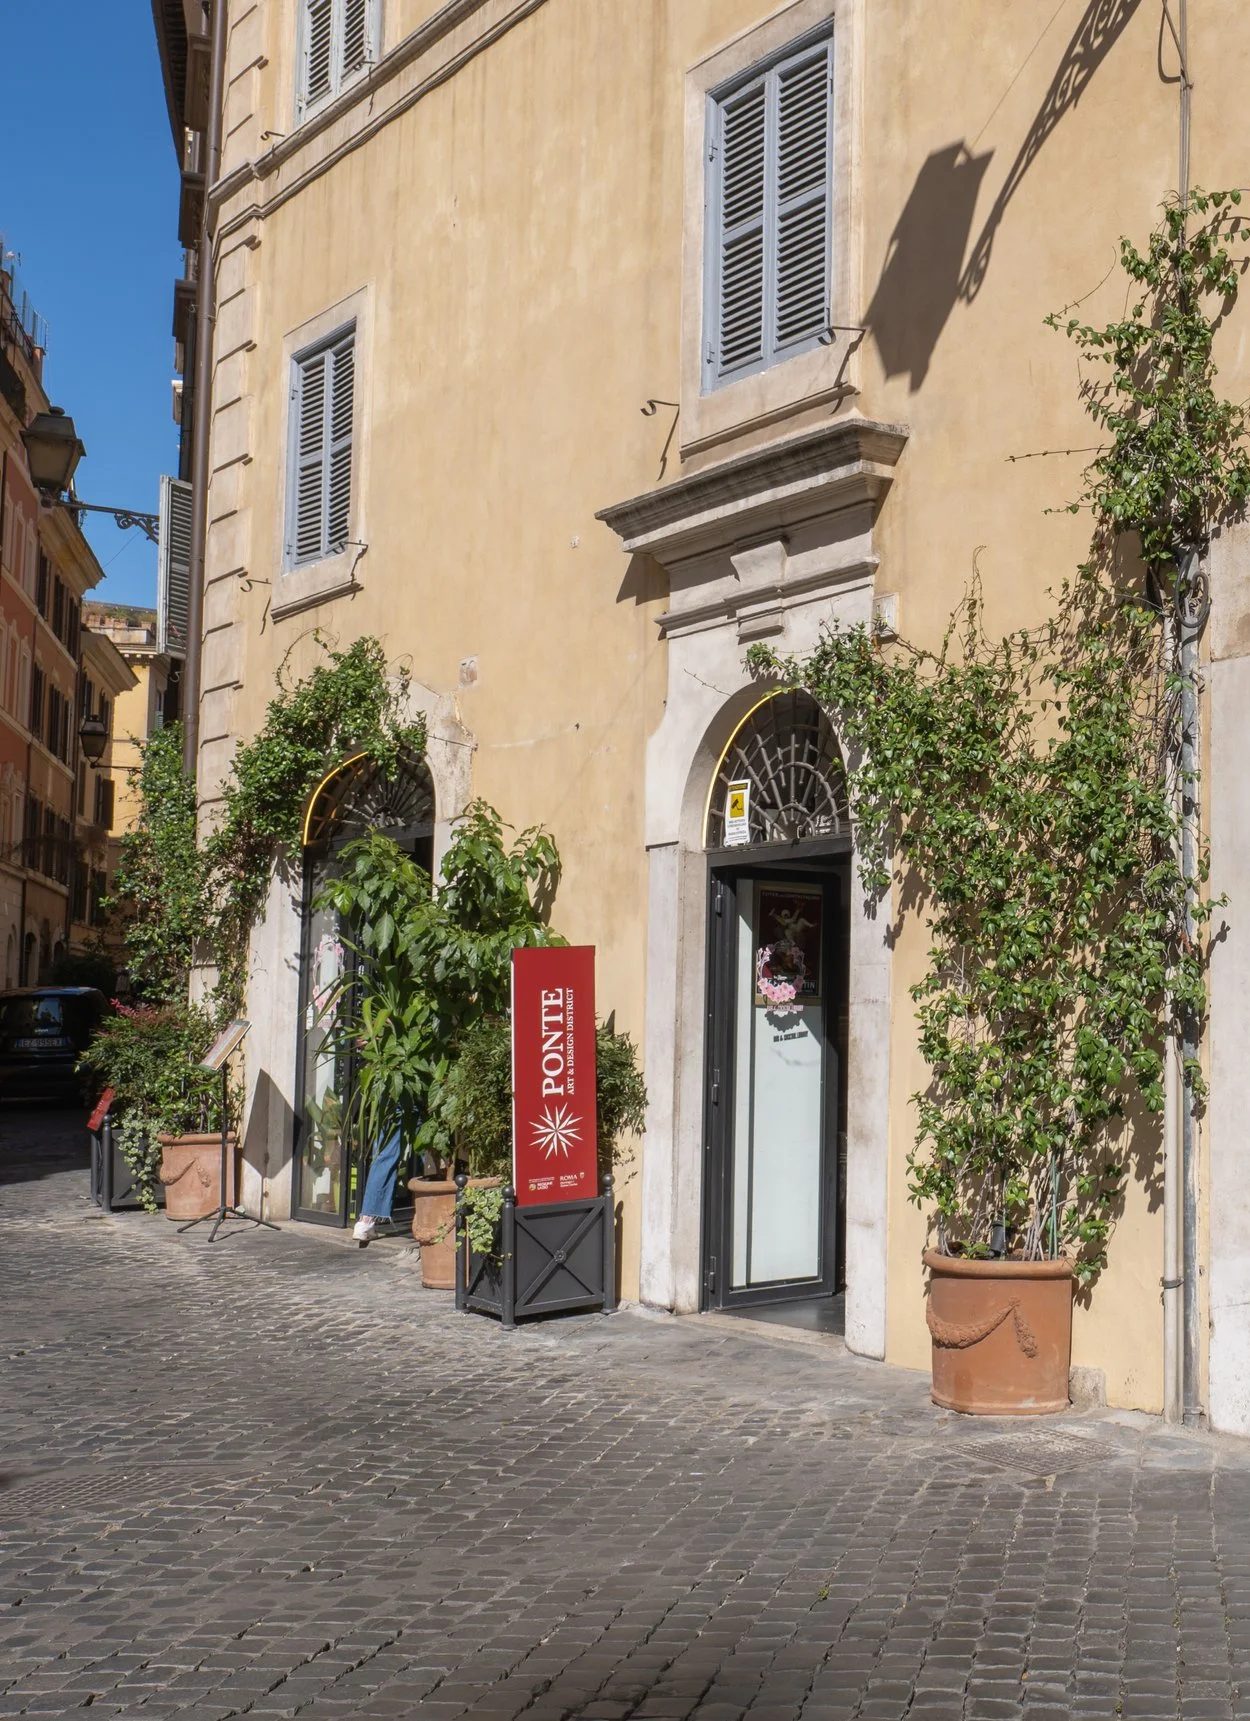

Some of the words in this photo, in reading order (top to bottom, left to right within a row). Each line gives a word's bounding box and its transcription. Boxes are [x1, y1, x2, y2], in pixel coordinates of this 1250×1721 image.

[566, 988, 575, 1031] DISTRICT
[541, 989, 564, 1098] PONTE
[566, 1033, 575, 1067] DESIGN
[566, 1077, 575, 1095] ART
